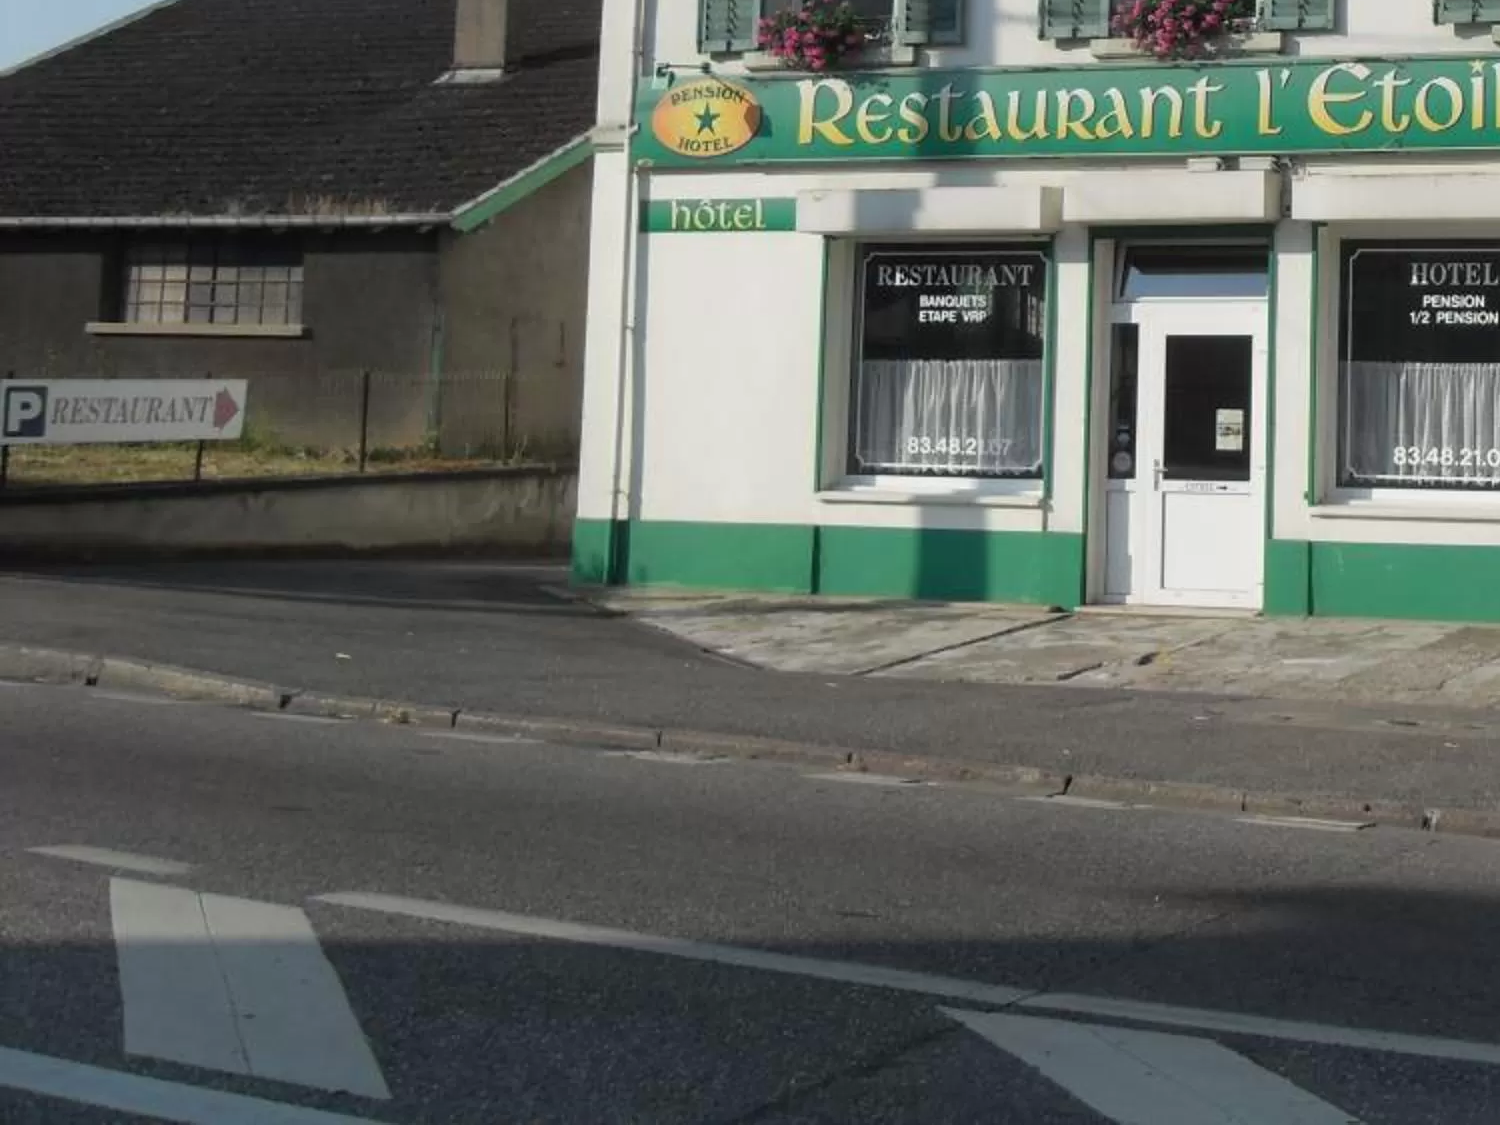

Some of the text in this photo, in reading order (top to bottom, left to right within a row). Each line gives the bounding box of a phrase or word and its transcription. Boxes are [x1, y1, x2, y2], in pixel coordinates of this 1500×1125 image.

[671, 84, 746, 107] PENSION
[796, 75, 1225, 146] Restaurant
[677, 136, 733, 152] HOTEL
[671, 197, 767, 230] hôtel
[876, 263, 1034, 288] RESTAURANT
[1408, 261, 1500, 287] HOTEL
[918, 293, 988, 309] BANQUETS
[1422, 293, 1486, 309] PENSION
[918, 309, 988, 323] ETAPE VRP
[1409, 310, 1500, 326] 1/2 PENSION
[7, 390, 214, 432] P RESTAURANT
